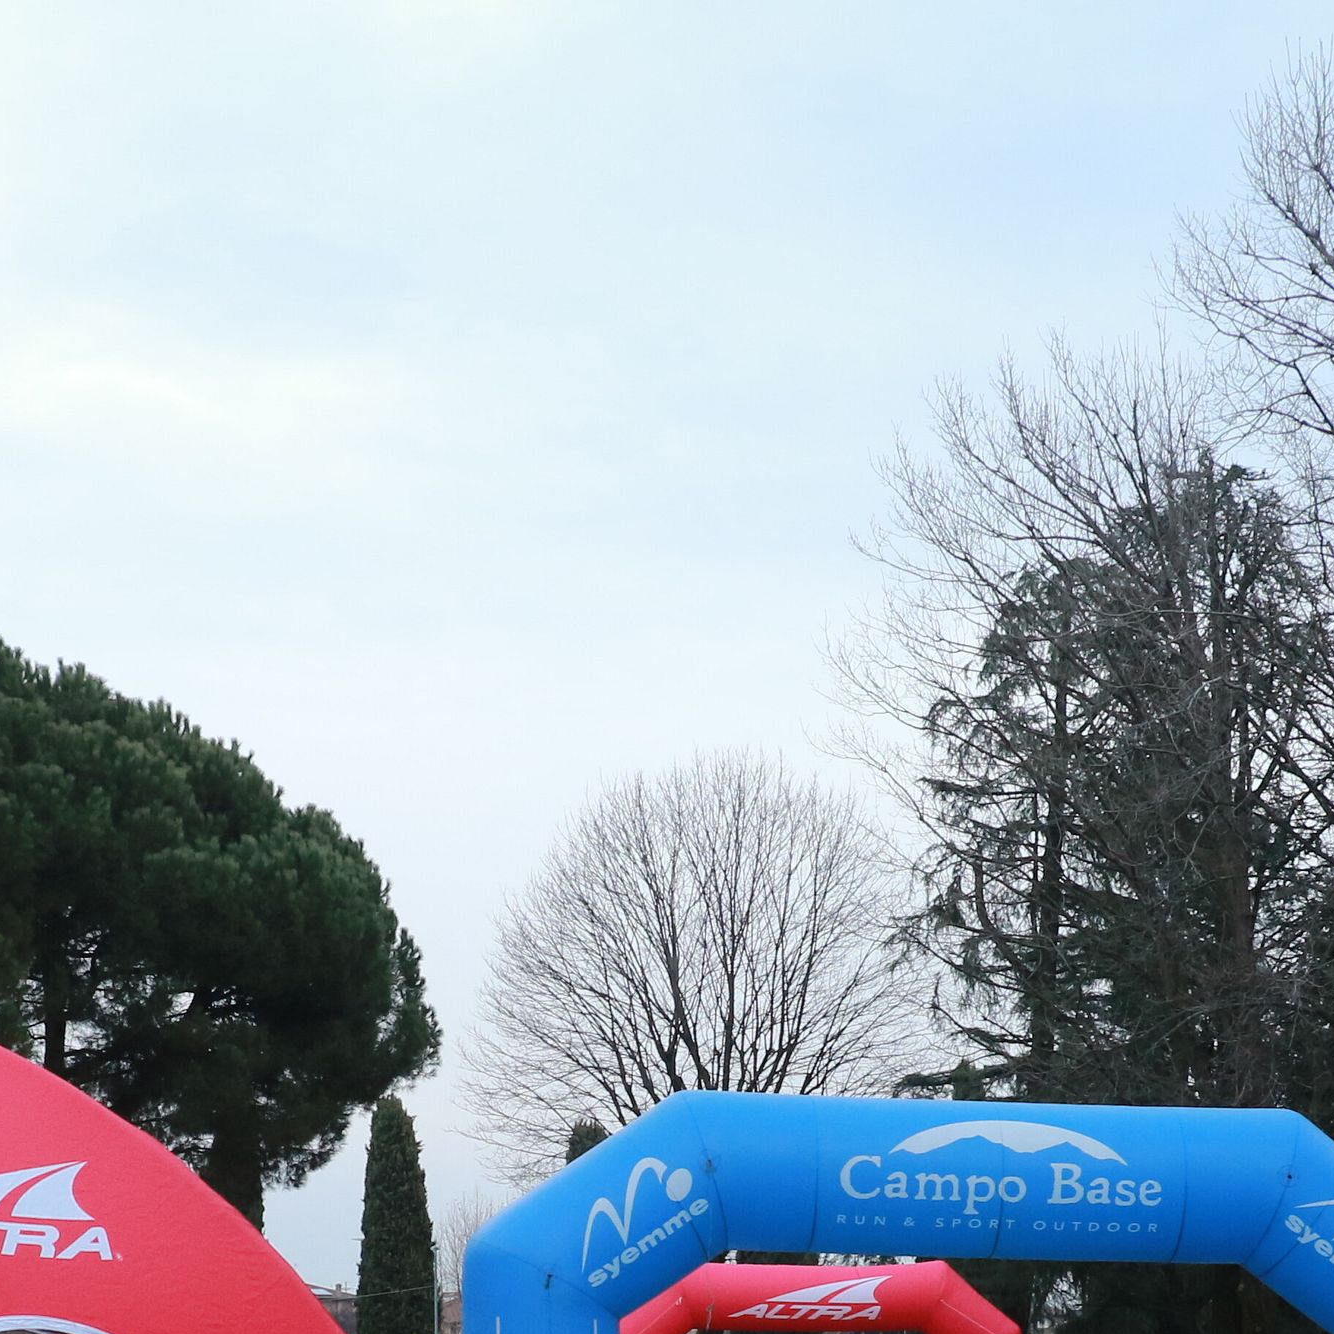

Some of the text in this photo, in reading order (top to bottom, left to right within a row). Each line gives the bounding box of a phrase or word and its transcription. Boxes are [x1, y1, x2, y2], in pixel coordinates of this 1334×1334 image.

[840, 1154, 1163, 1215] Campo Base
[588, 1198, 709, 1288] syemme
[837, 1213, 1158, 1233] RUN & SPORT OUTDOOR
[728, 1303, 881, 1321] ALTRA
